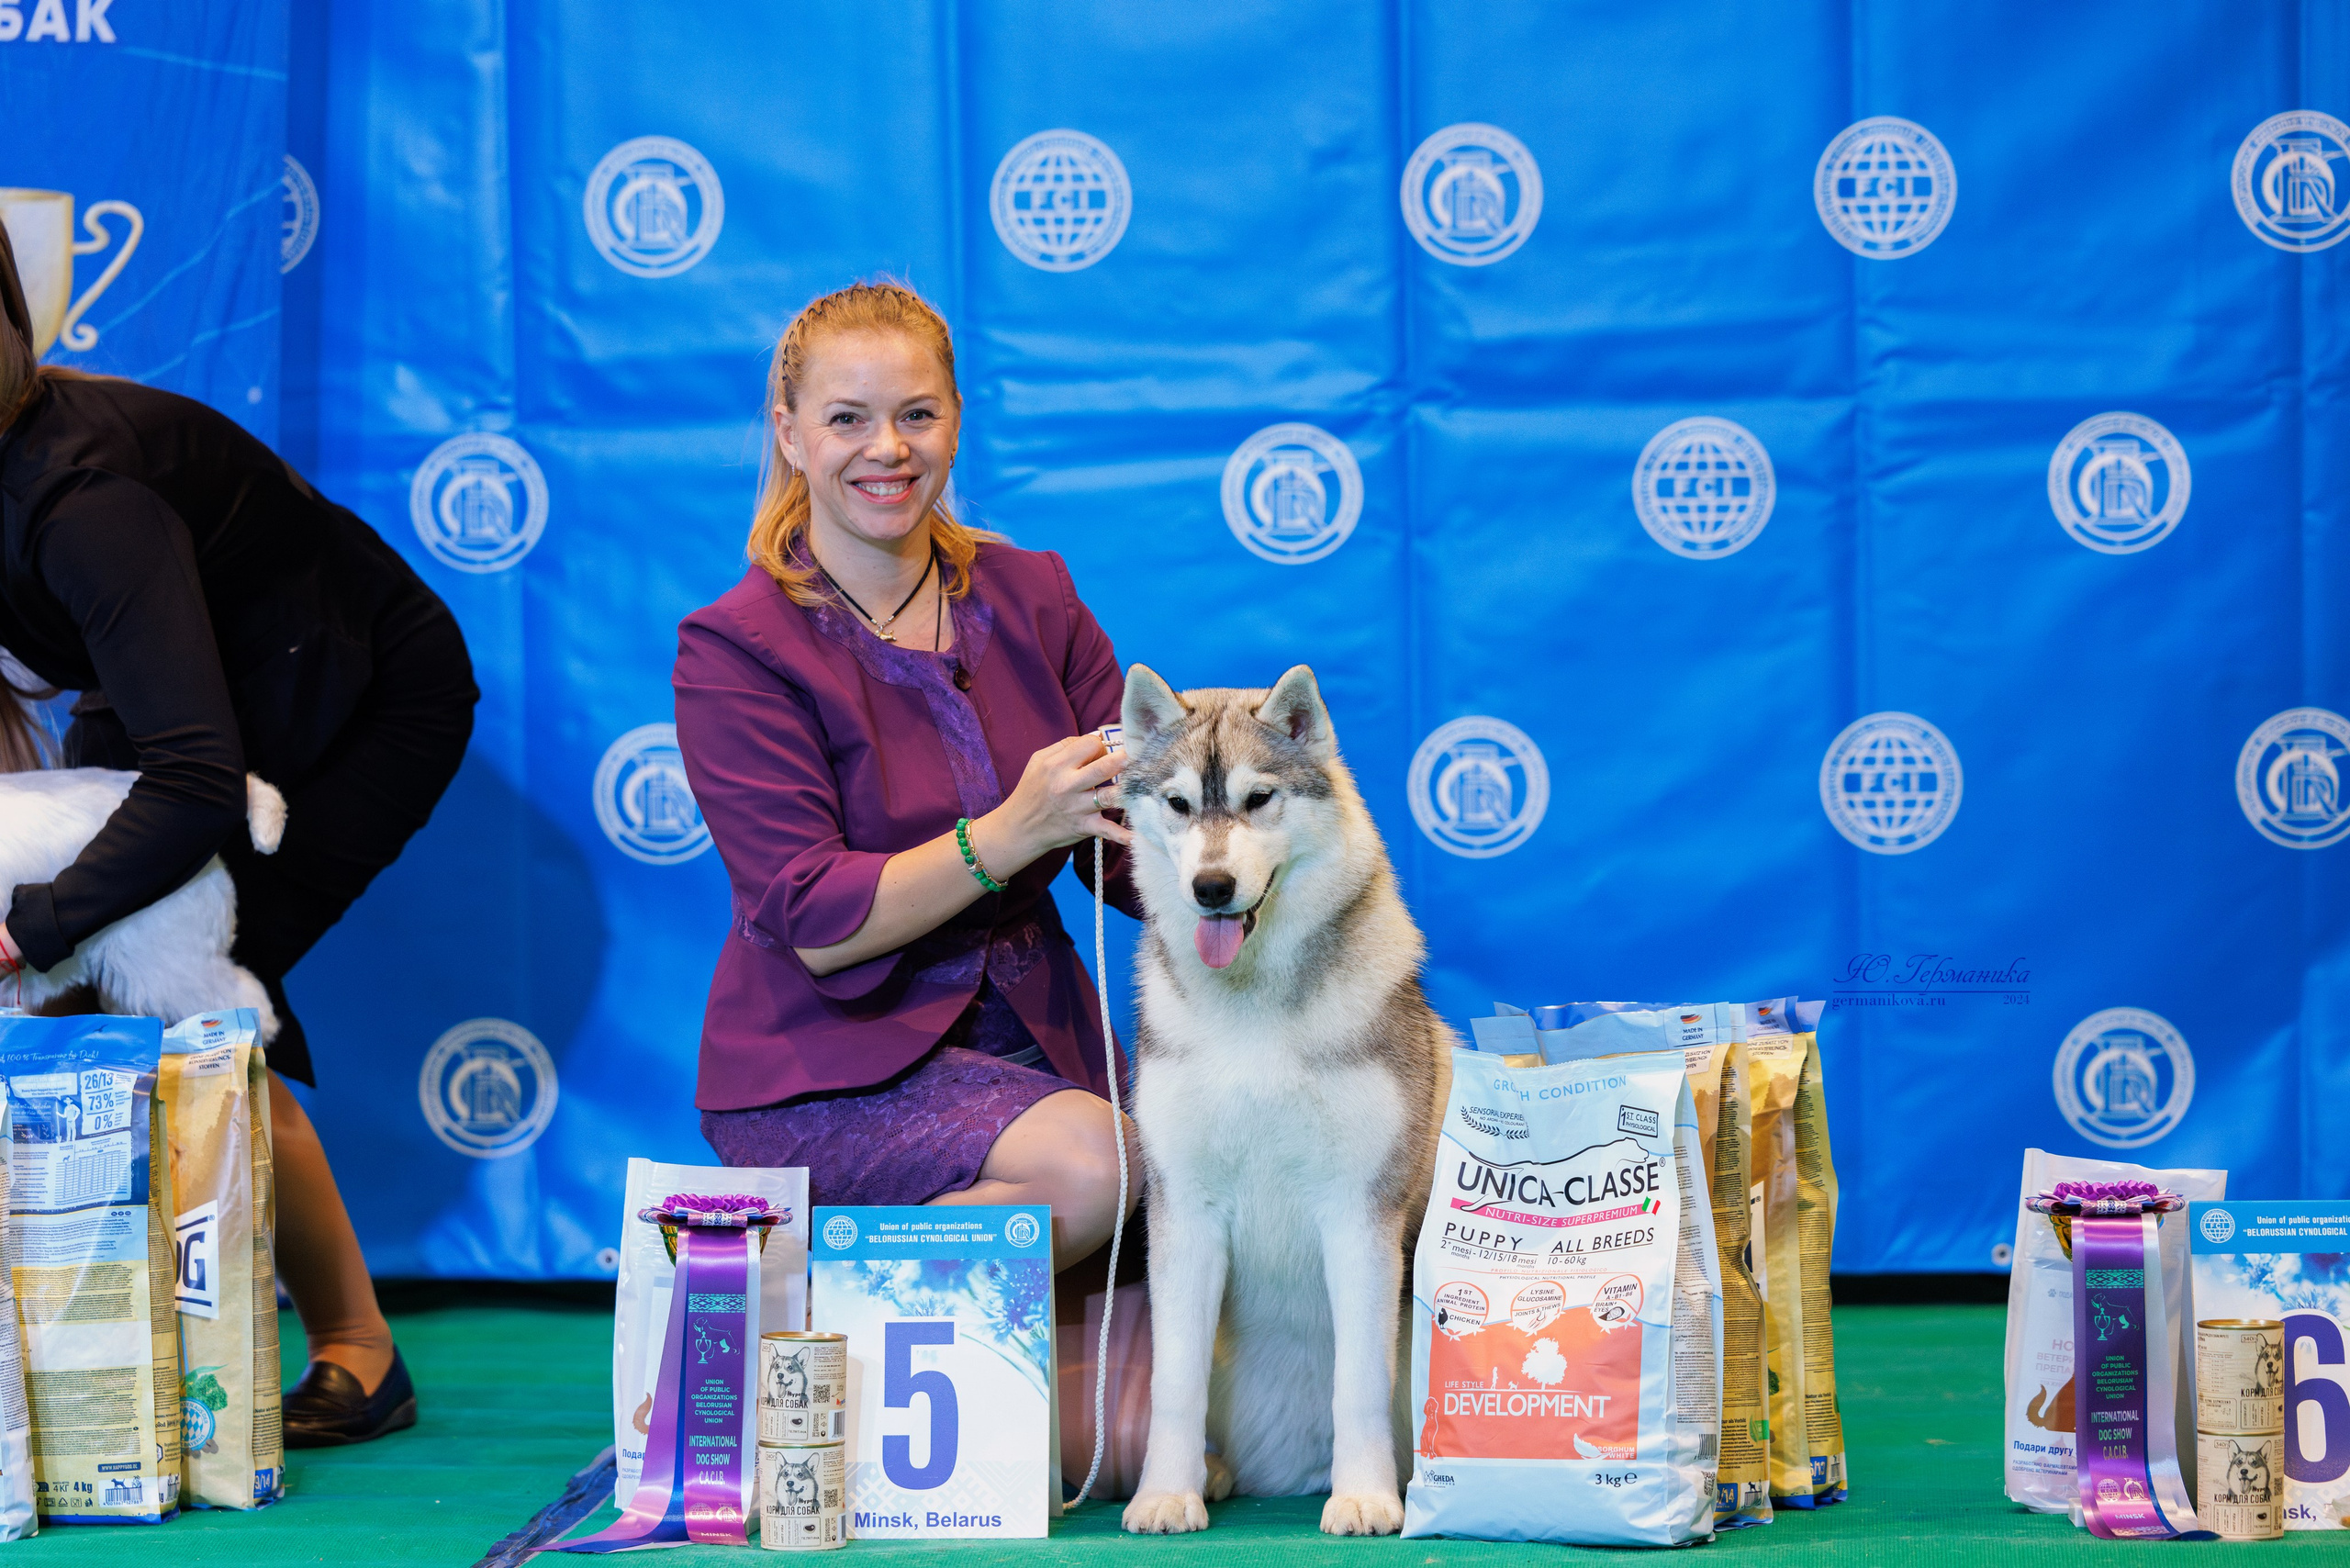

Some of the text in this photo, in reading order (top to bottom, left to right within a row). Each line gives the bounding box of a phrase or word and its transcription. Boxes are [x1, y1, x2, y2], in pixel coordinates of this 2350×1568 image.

[84, 1071, 114, 1091] 26/13
[1539, 1075, 1627, 1101] CONDITION
[88, 1092, 114, 1111] 73 %
[95, 1114, 113, 1130] 0 %
[1636, 1114, 1656, 1125] CLASS
[1626, 1122, 1656, 1132] PHYSIOLOGICAL
[1485, 1206, 1638, 1226] NUTRI-SIZE SUPERPREMIUM
[2256, 1216, 2277, 1225] Union
[2279, 1215, 2286, 1224] of
[2288, 1215, 2310, 1226] public
[879, 1222, 982, 1232] Union of public organizations
[2299, 1227, 2347, 1236] CYNOLOGICAL
[920, 1234, 969, 1243] CYNOLOGICAL
[1444, 1222, 1523, 1250] PUPPY
[1551, 1227, 1654, 1253] ALL BREEDS
[1451, 1251, 1470, 1260] months
[1452, 1245, 1472, 1255] mesi
[1479, 1249, 1517, 1263] 12/15/18
[1604, 1282, 1638, 1294] VITAMIN
[1444, 1294, 1480, 1305] INGREDIENT
[1460, 1302, 1485, 1311] PROTEIN
[1542, 1303, 1561, 1311] THEWS
[1449, 1314, 1481, 1325] CHICKEN
[2241, 1388, 2273, 1398] КОРМ ДЛЯ
[2284, 1314, 2350, 1484] 6
[771, 1399, 784, 1407] ДЛЯ
[785, 1399, 808, 1408] СОБАК
[882, 1321, 959, 1490] 5
[1444, 1394, 1611, 1418] DEVELOPMENT
[2091, 1410, 2139, 1423] INTERNATIONAL
[2098, 1428, 2132, 1441] DOG SHOW
[688, 1435, 738, 1448] INTERNATIONAL
[2013, 1440, 2074, 1457] Подари другу
[696, 1453, 731, 1465] DOG SHOW
[1595, 1473, 1621, 1487] 3 kg
[73, 1481, 93, 1494] 4 kg
[2214, 1494, 2271, 1504] КОРМ ДЛЯ СОБАК
[767, 1506, 820, 1516] КОРМ ДЛЯ СОБАК
[854, 1510, 1002, 1531] Minsk, Belarus
